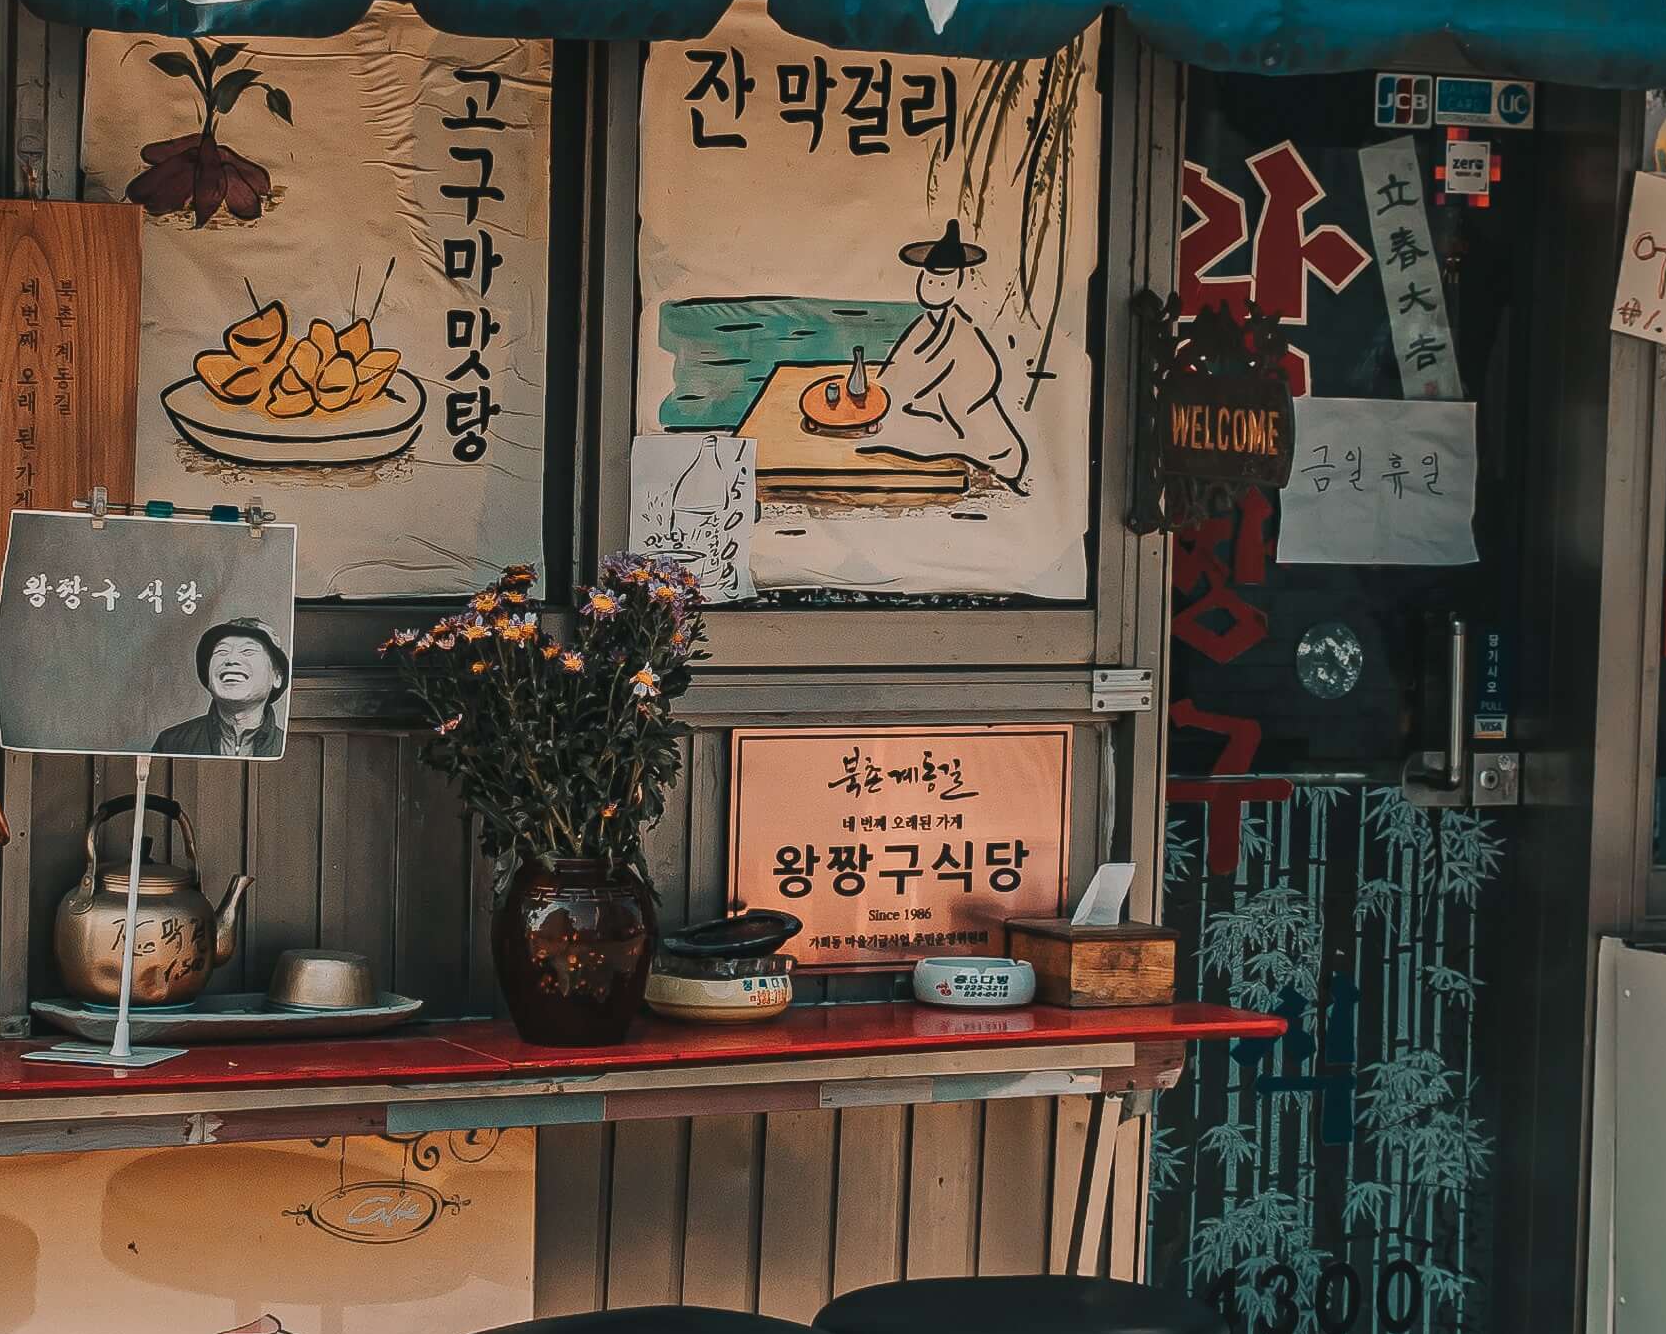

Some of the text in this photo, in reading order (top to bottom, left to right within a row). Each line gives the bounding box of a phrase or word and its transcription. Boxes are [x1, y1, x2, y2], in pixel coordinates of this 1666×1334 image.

[683, 47, 959, 162] 잔 막걸리
[1377, 92, 1428, 109] JCB
[1499, 94, 1529, 115] UC
[1452, 158, 1484, 170] zero
[1376, 173, 1445, 371] 立春大吉
[1171, 403, 1279, 456] WELCOME
[1300, 445, 1444, 499] 금일 휴일
[1486, 634, 1500, 694] 당기시오
[1481, 700, 1504, 711] PULL
[827, 747, 980, 801] 북촌 계동길
[772, 839, 1031, 899] 왕짱구식당
[868, 907, 933, 923] Since 1986
